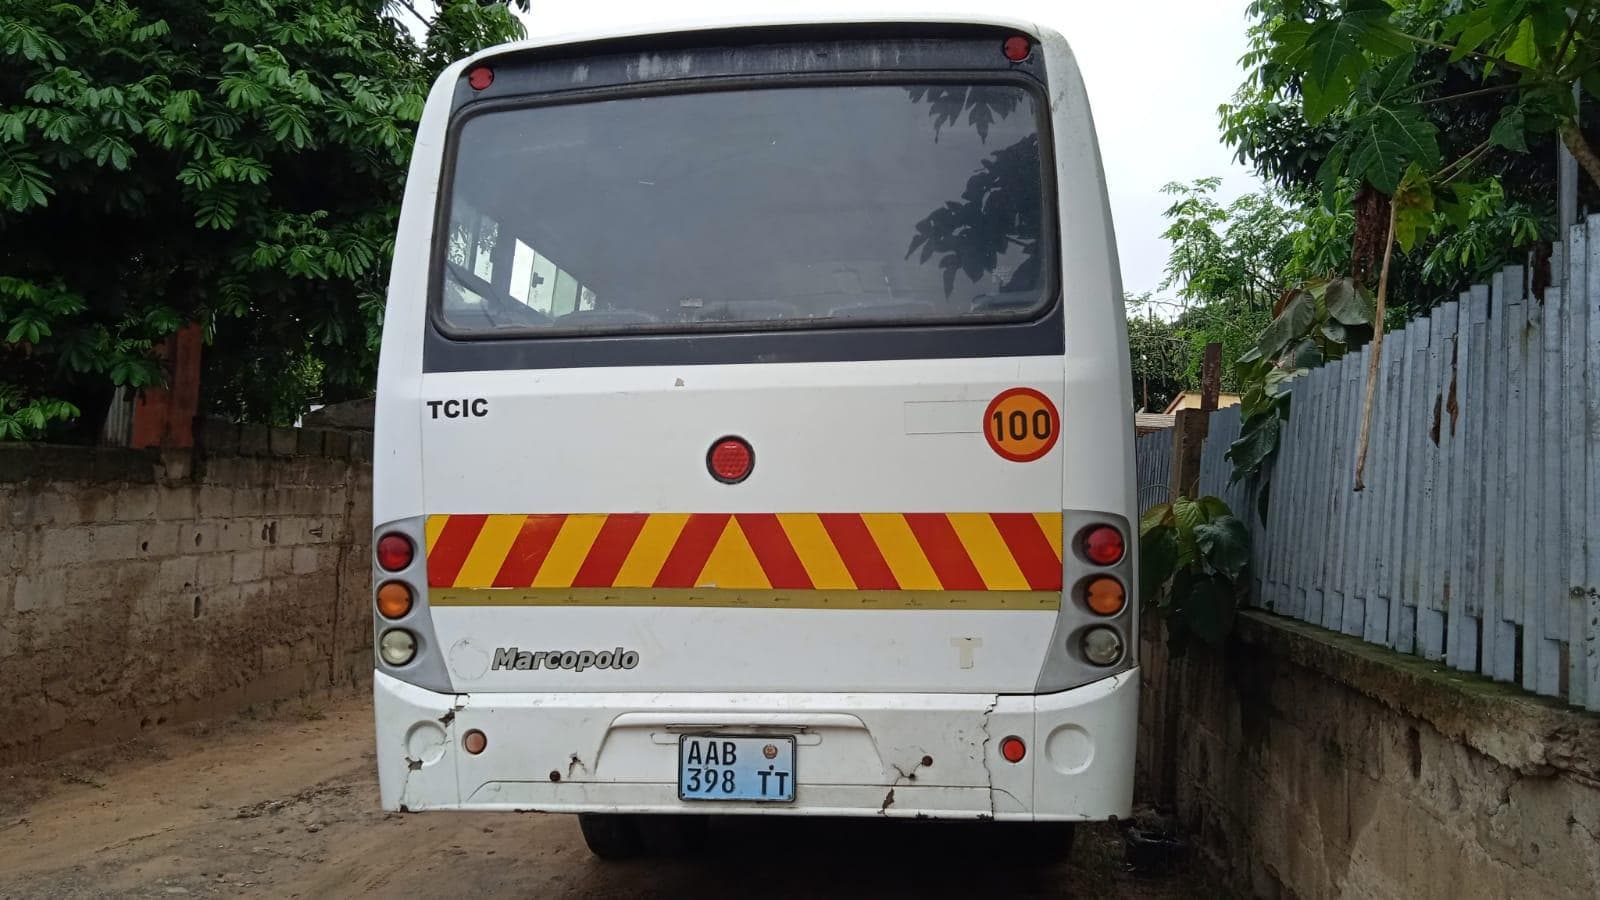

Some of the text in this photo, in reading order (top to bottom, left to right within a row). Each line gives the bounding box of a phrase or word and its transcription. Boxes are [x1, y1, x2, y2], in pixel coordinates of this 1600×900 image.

[427, 398, 489, 419] TCIC
[993, 409, 1051, 442] 100
[491, 647, 639, 672] Marcopolo
[687, 740, 737, 766] AAB
[686, 767, 736, 793] 398
